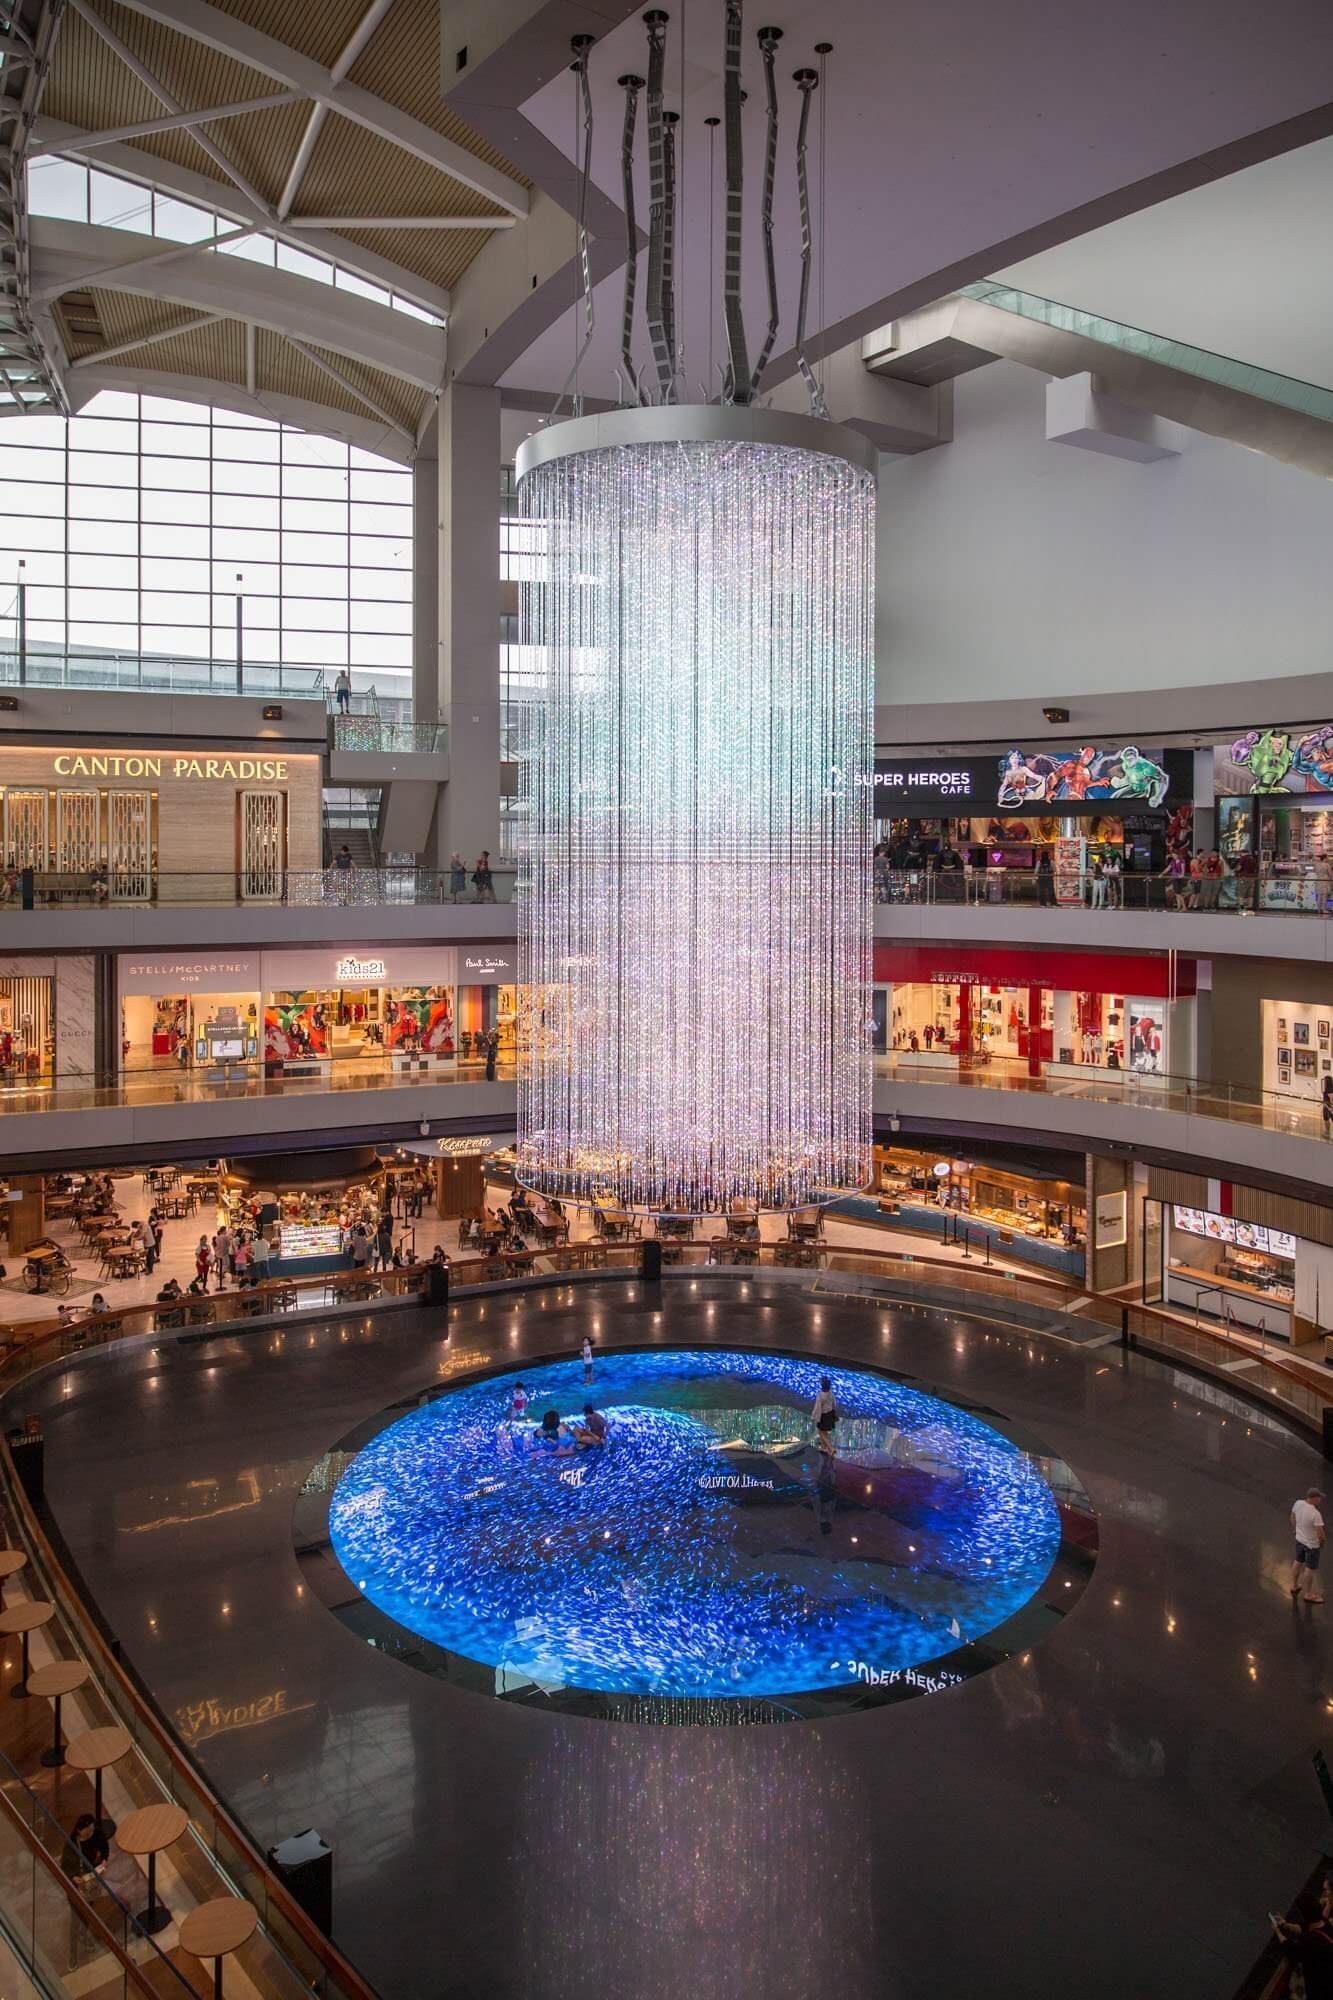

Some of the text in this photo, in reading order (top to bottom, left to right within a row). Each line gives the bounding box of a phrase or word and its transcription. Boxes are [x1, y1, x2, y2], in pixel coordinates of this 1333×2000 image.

[54, 756, 288, 780] CANTON PARADISE
[853, 773, 970, 786] SUPER HEROES
[941, 786, 971, 794] CAFE
[339, 959, 385, 975] kids21
[465, 958, 509, 967] Paul Smith
